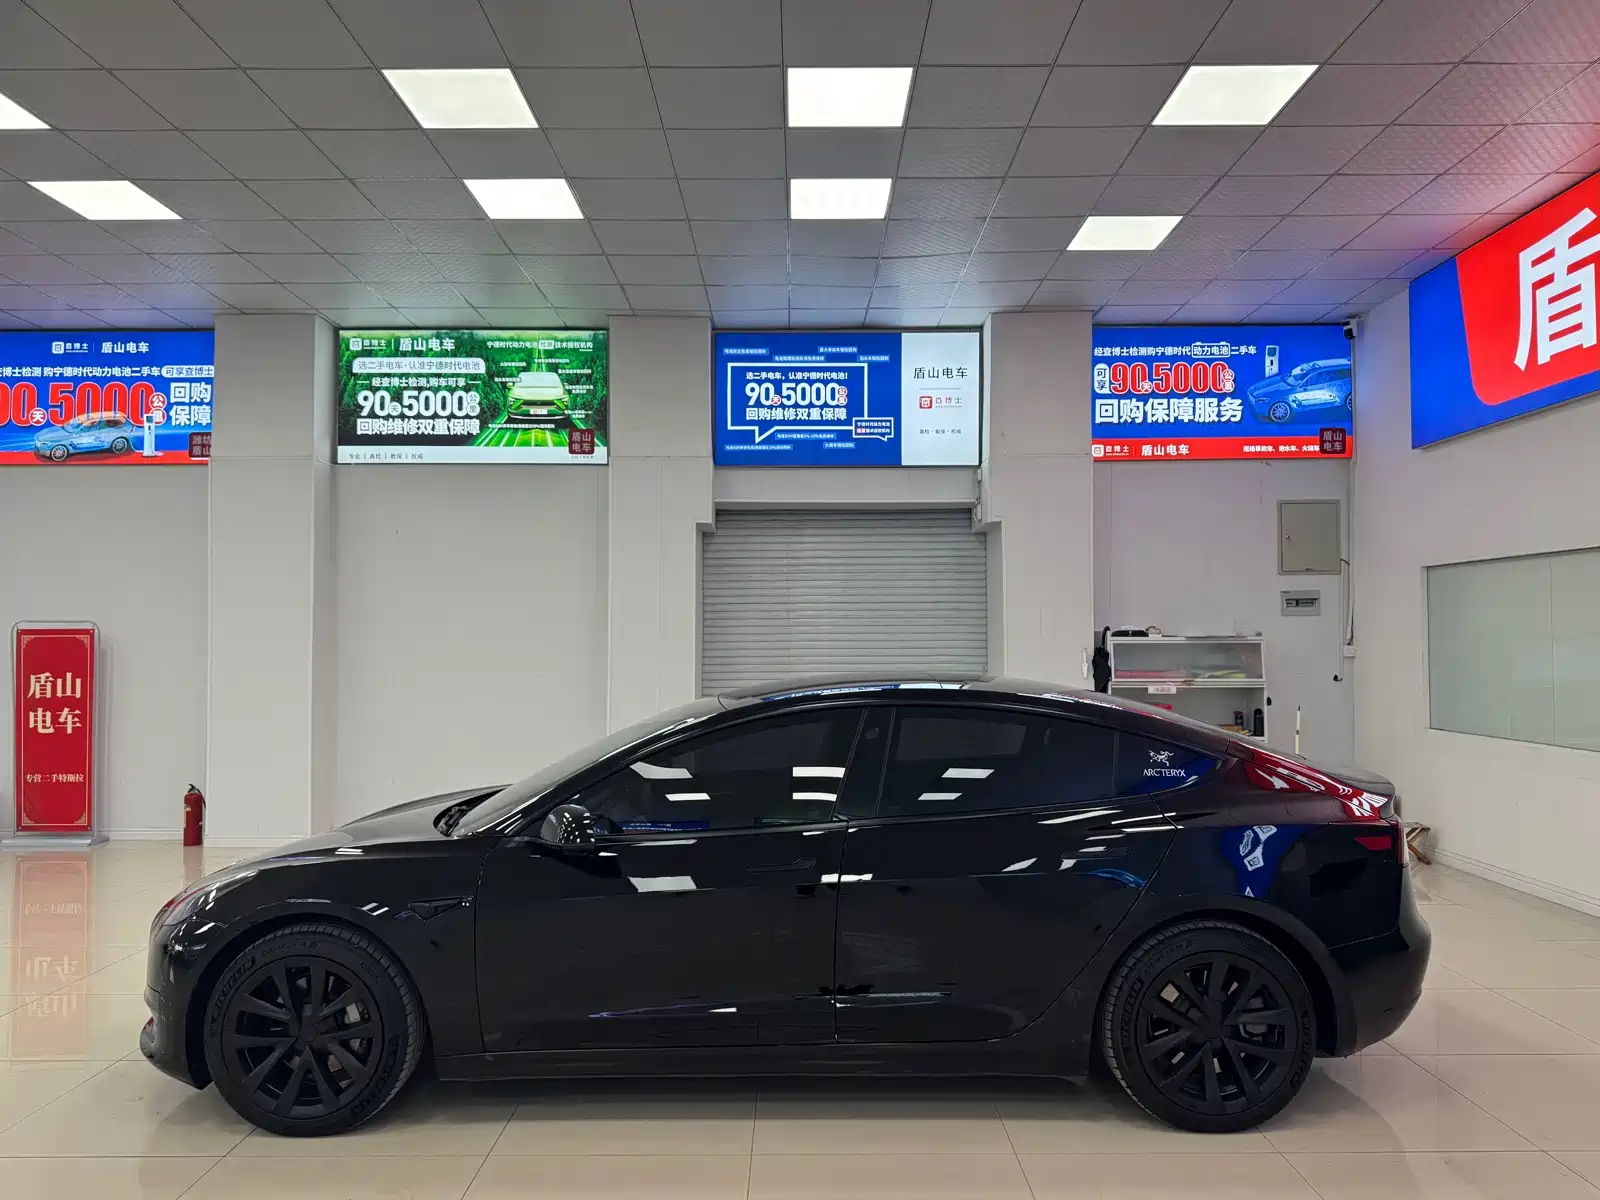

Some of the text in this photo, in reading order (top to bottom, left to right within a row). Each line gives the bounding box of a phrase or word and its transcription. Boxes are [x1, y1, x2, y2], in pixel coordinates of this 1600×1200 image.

[1513, 206, 1600, 372] 盾
[101, 341, 149, 354] 盾山电车
[399, 337, 456, 351] 盾山电车
[0, 366, 42, 378] 博士检测
[913, 366, 968, 380] 盾山电车
[169, 382, 212, 403] 回购
[169, 405, 212, 427] 保障
[745, 407, 848, 421] 回购维修双重保障
[1095, 397, 1244, 424] 回购保障服务
[356, 418, 481, 436] 回购维修双重保障
[572, 431, 592, 442] 盾山
[1323, 430, 1343, 441] 盾山
[572, 443, 592, 453] 电车
[1141, 443, 1190, 456] 盾山电车
[1323, 441, 1343, 452] 电车
[27, 671, 82, 699] 盾山
[28, 707, 82, 735] 电车
[25, 773, 85, 784] 专营二手特斯拉
